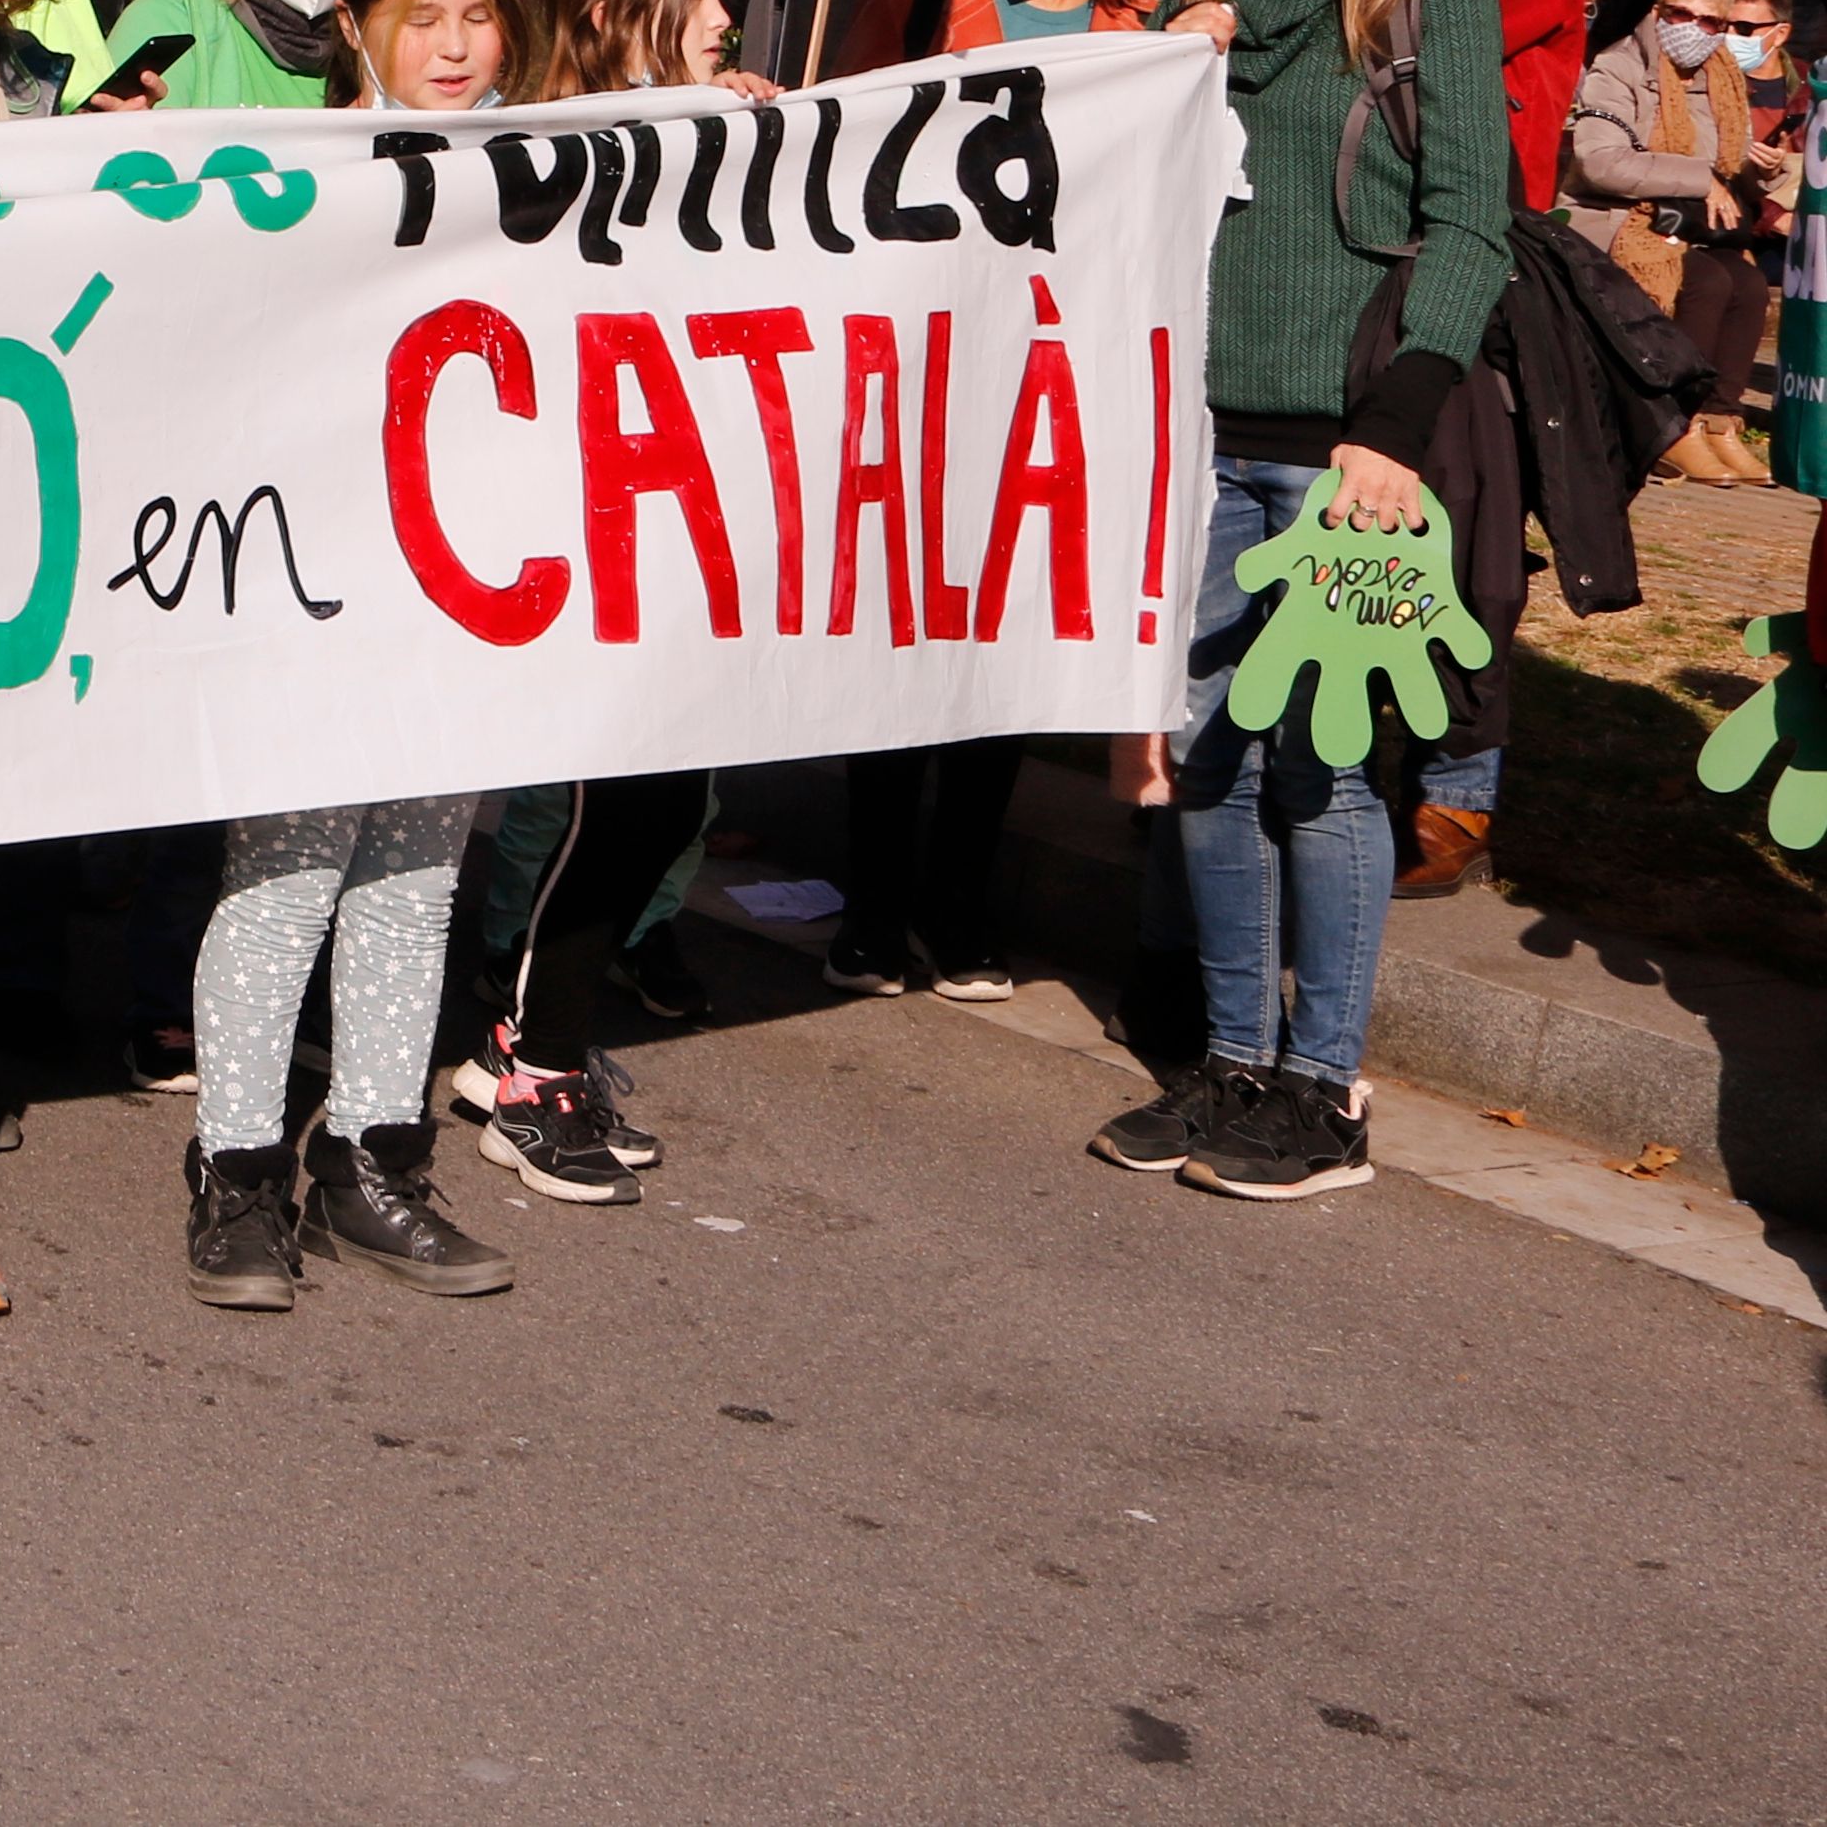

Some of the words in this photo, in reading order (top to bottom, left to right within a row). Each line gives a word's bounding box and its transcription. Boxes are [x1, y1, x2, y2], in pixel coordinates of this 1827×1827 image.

[106, 483, 344, 615] en
[1291, 554, 1426, 613] escola
[1347, 589, 1449, 632] som
